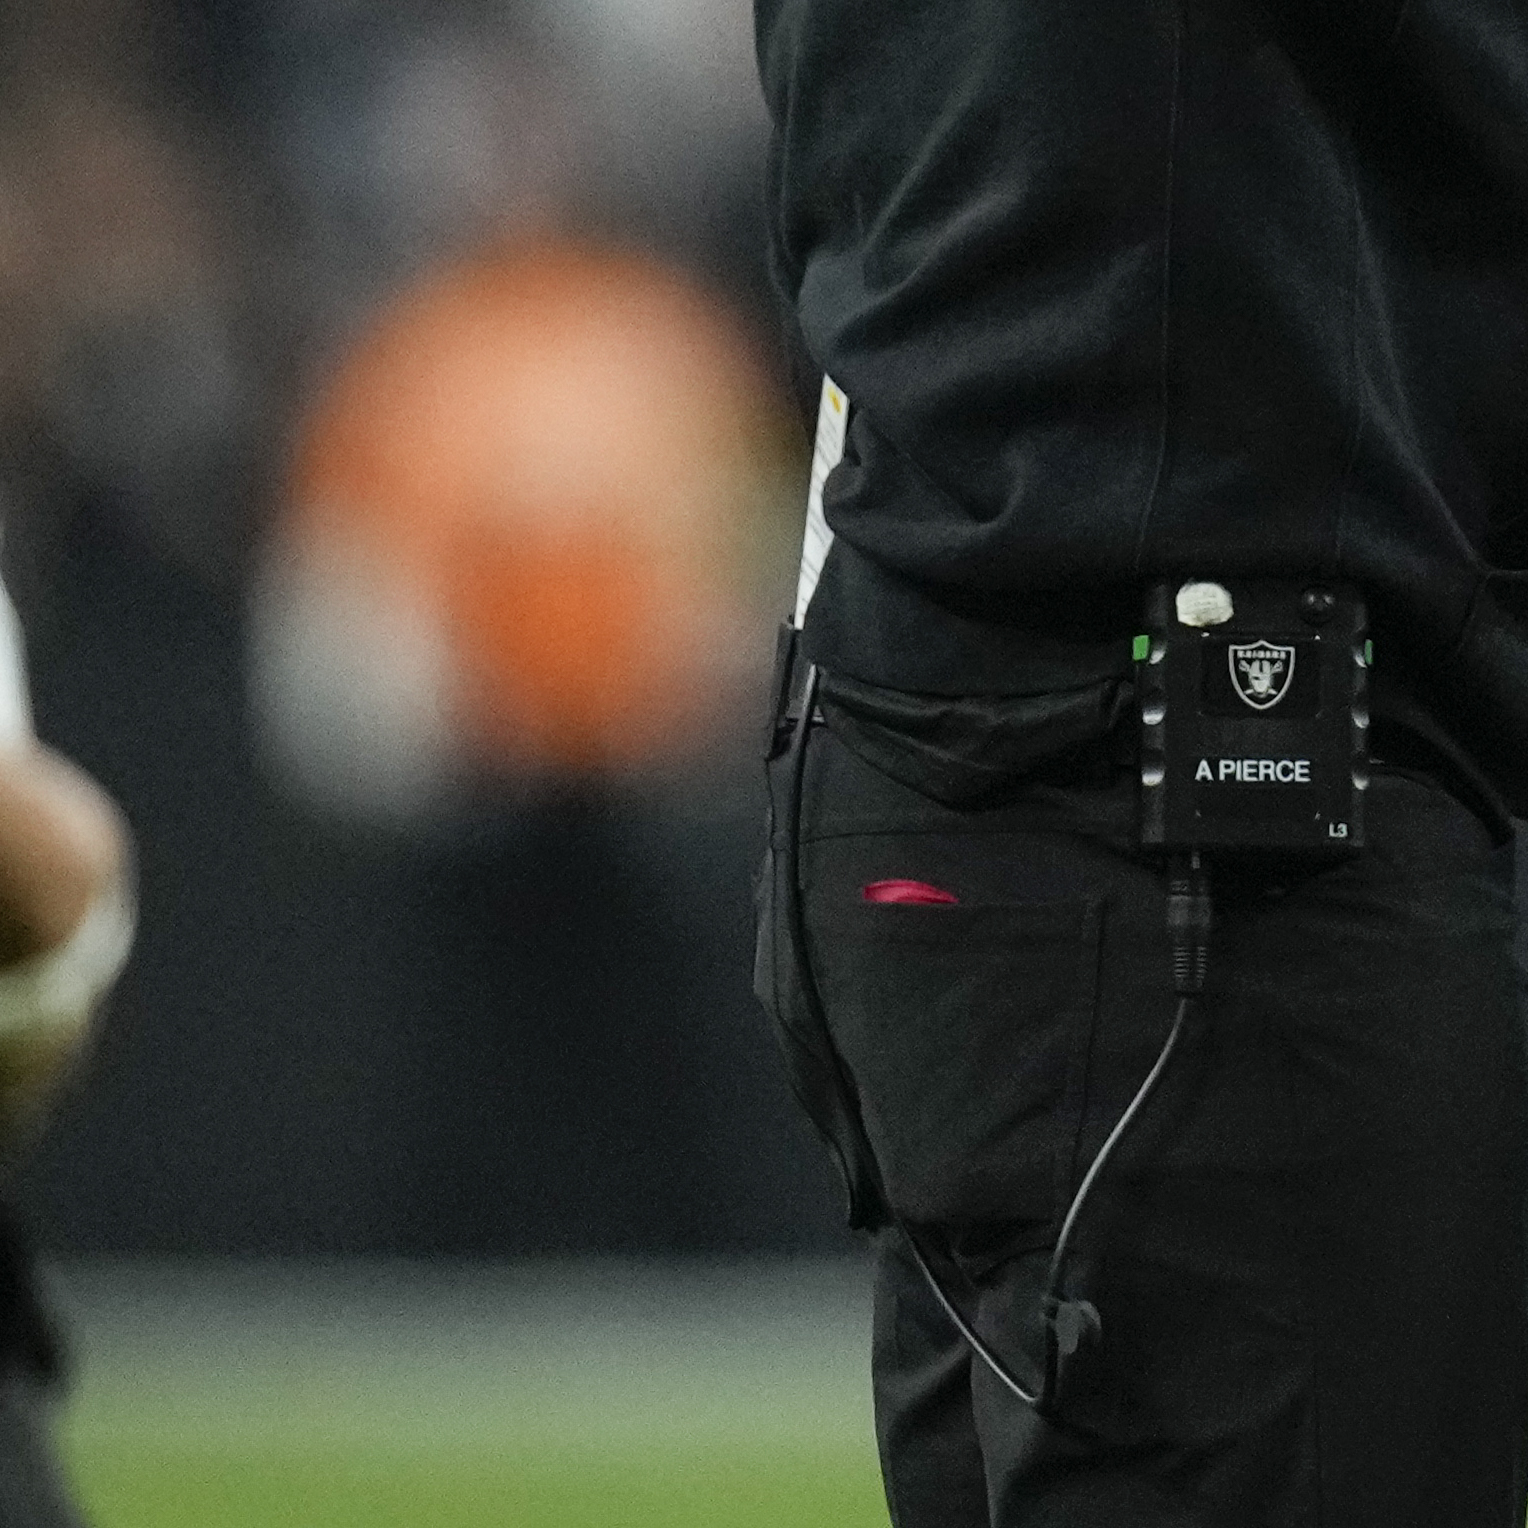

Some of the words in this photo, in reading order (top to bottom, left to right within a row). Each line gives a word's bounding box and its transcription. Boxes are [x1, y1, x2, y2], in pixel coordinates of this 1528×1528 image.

[1194, 759, 1214, 781] A
[1218, 759, 1311, 782] PIERCE
[1328, 822, 1348, 838] L3
